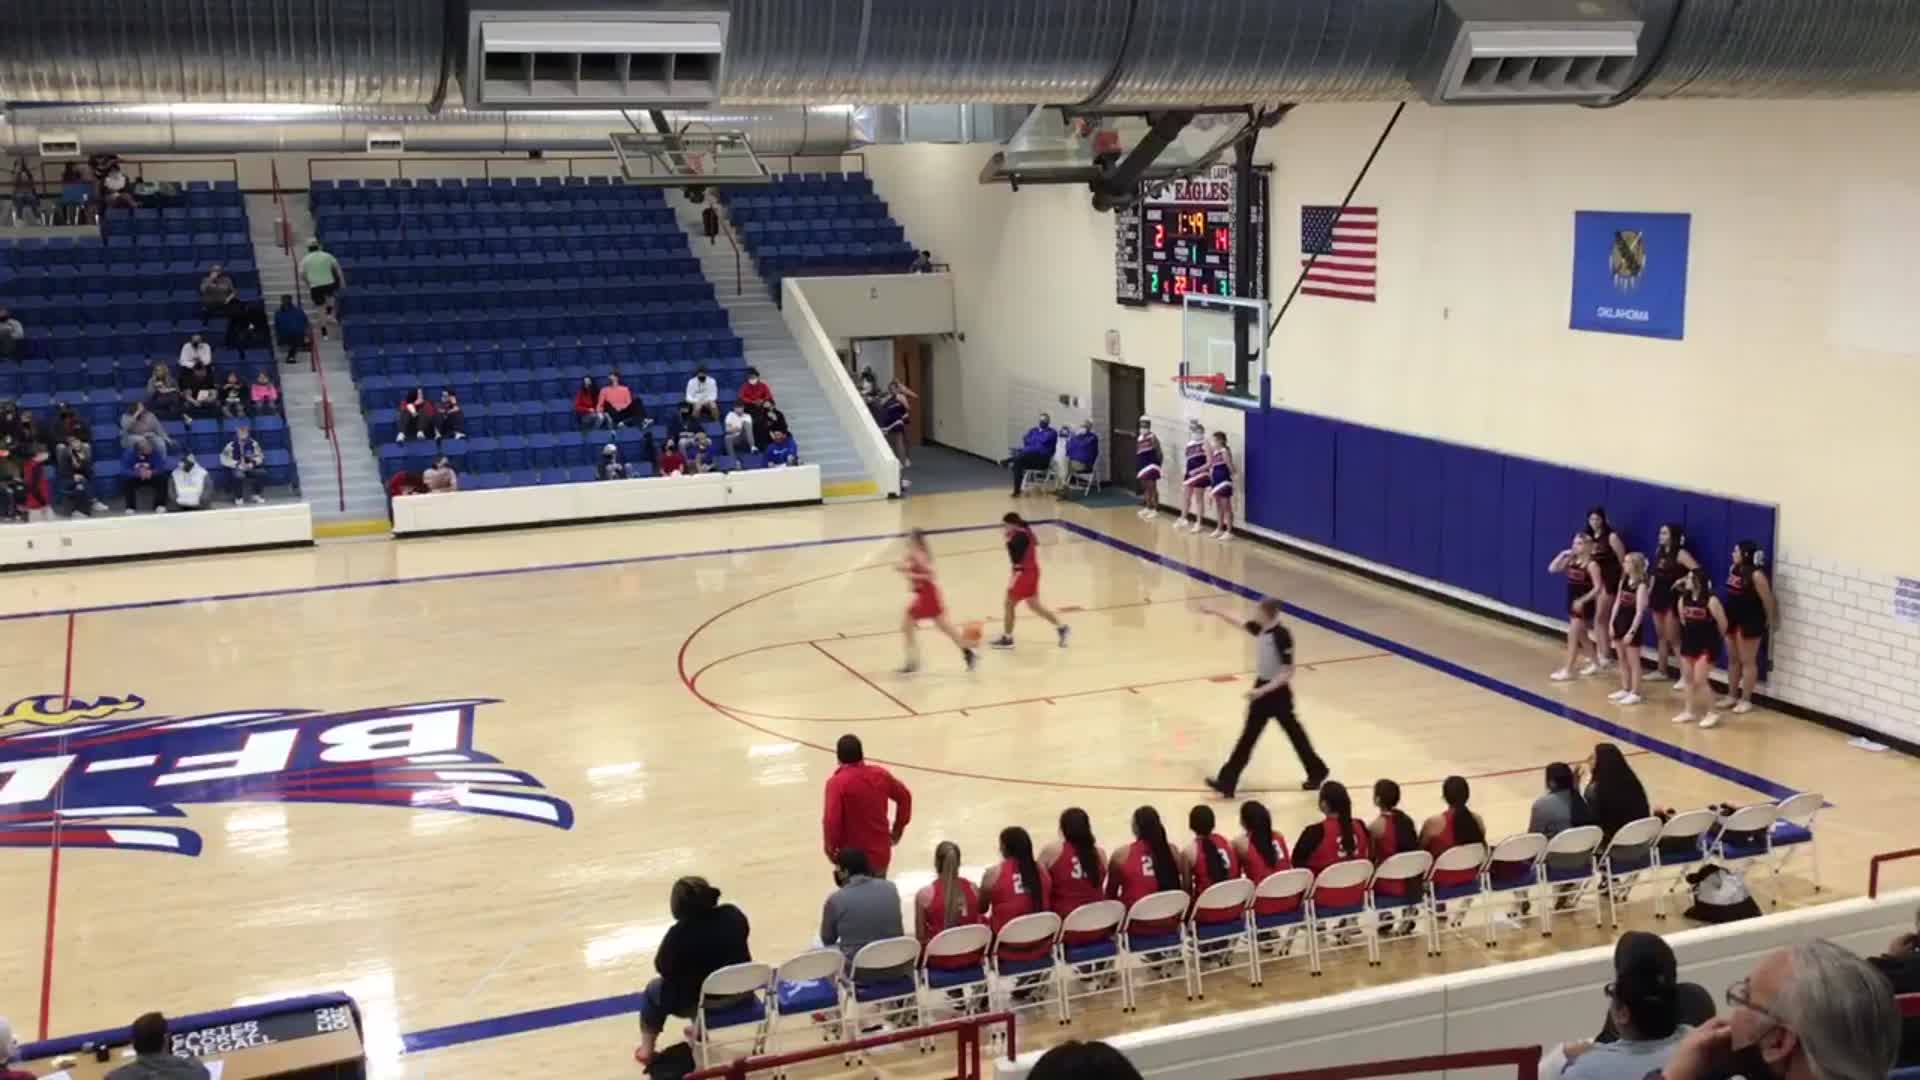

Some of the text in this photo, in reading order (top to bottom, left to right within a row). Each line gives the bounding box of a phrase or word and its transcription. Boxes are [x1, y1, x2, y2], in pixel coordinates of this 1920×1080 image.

[1175, 181, 1229, 201] EAGLES
[1178, 211, 1204, 235] 1:49
[1154, 224, 1164, 248] 2
[1215, 228, 1228, 251] 14
[1151, 273, 1159, 293] 2
[1174, 275, 1187, 294] 22
[1596, 306, 1649, 321] OKLAHOMA
[0, 709, 460, 805] BF-
[1141, 855, 1155, 877] 2
[1011, 873, 1025, 894] 2
